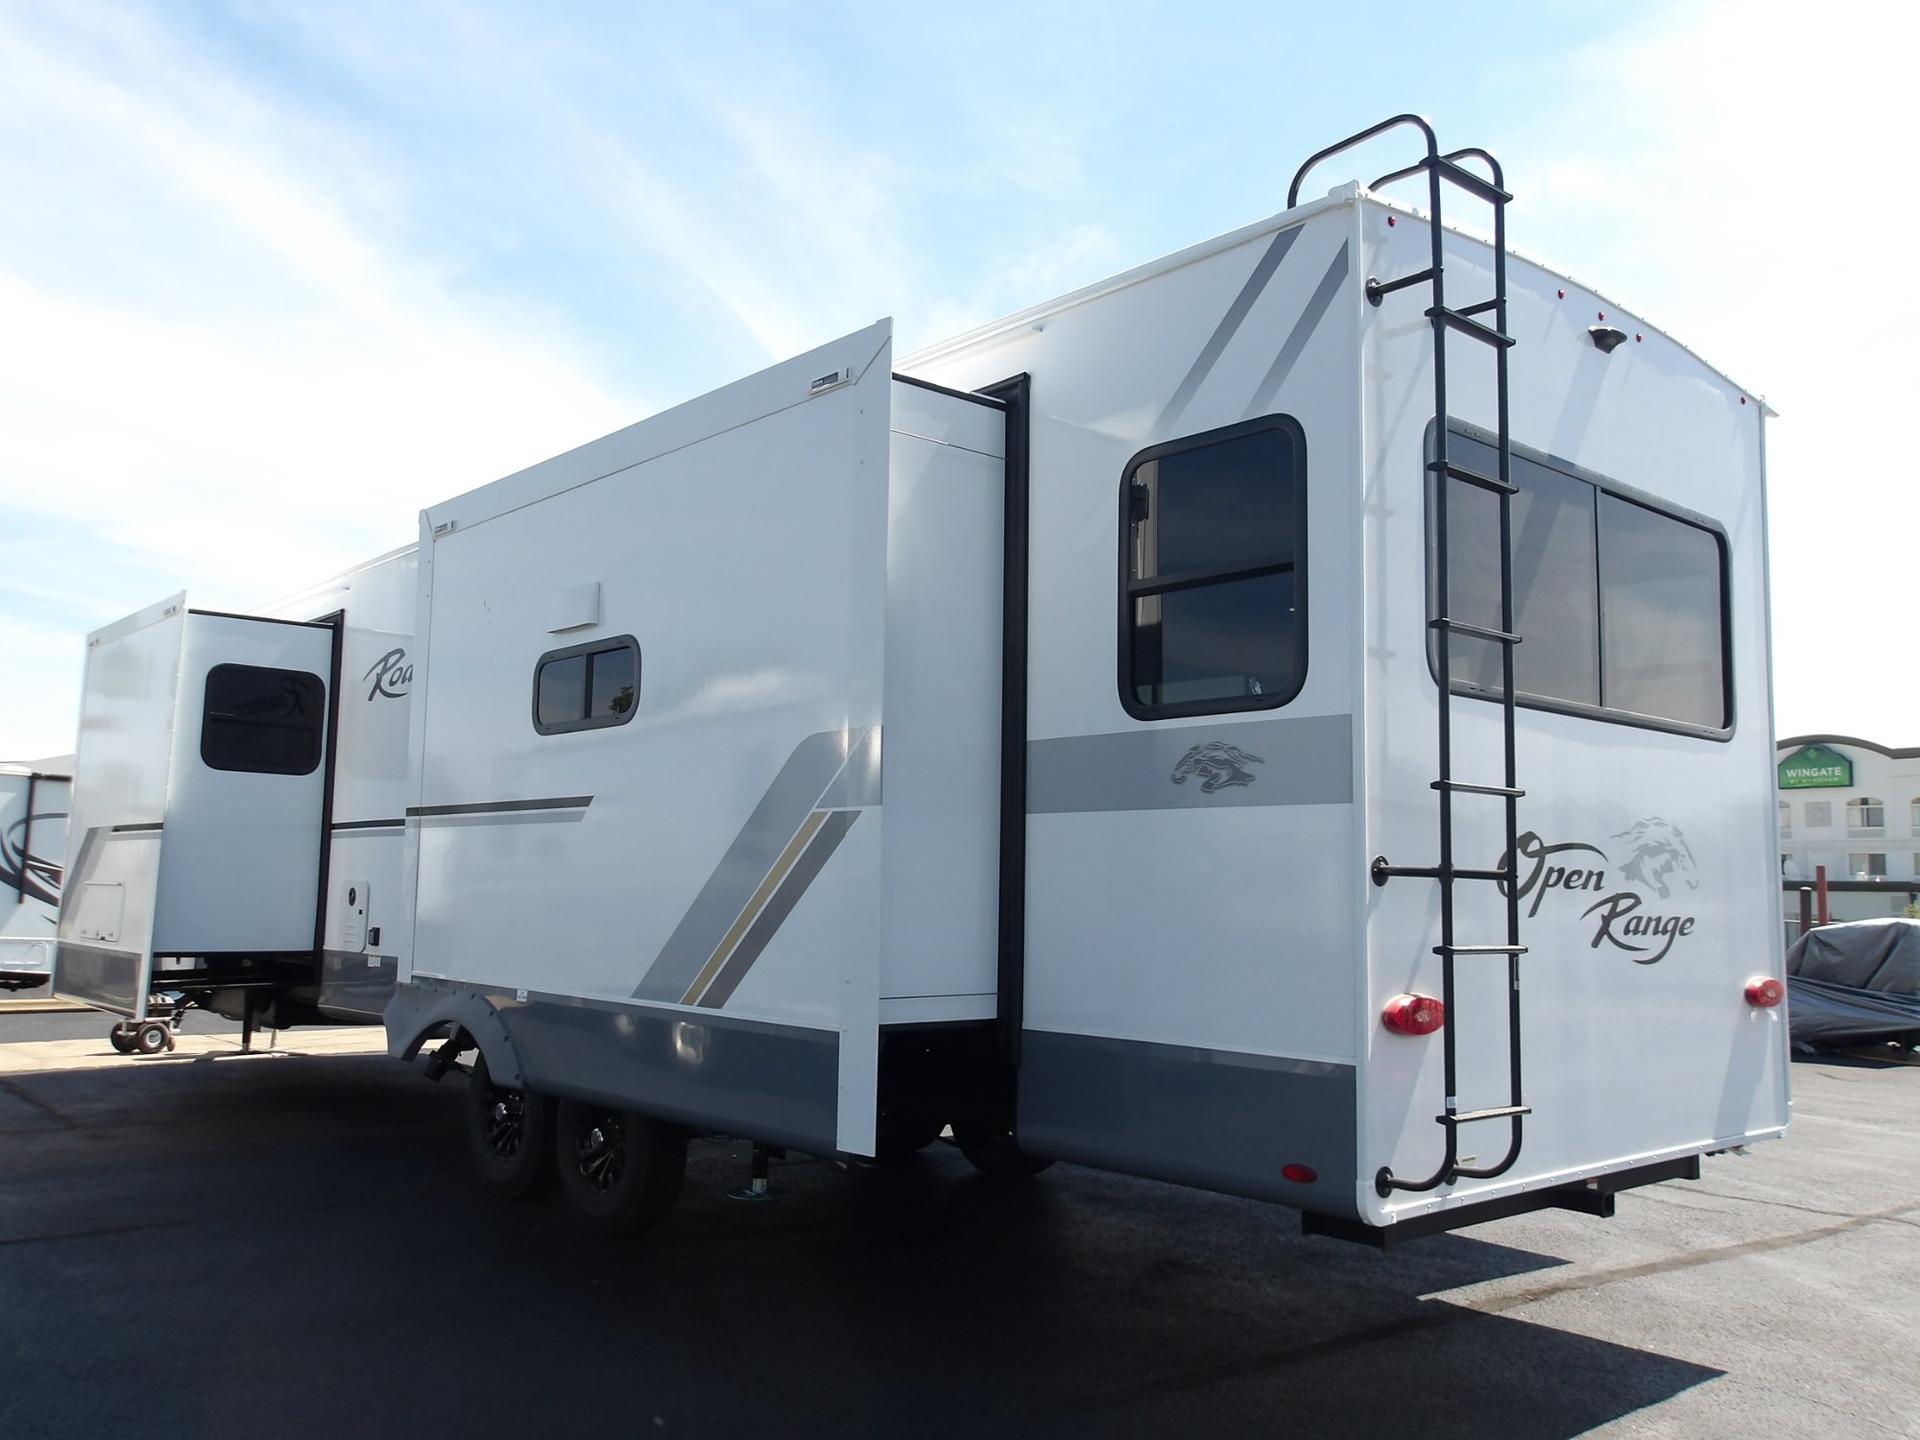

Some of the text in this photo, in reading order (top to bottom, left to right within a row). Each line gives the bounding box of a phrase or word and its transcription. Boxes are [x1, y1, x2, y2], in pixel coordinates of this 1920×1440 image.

[1785, 766, 1842, 778] WINGATE
[1497, 831, 1609, 918] Open
[1579, 892, 1695, 965] Range
